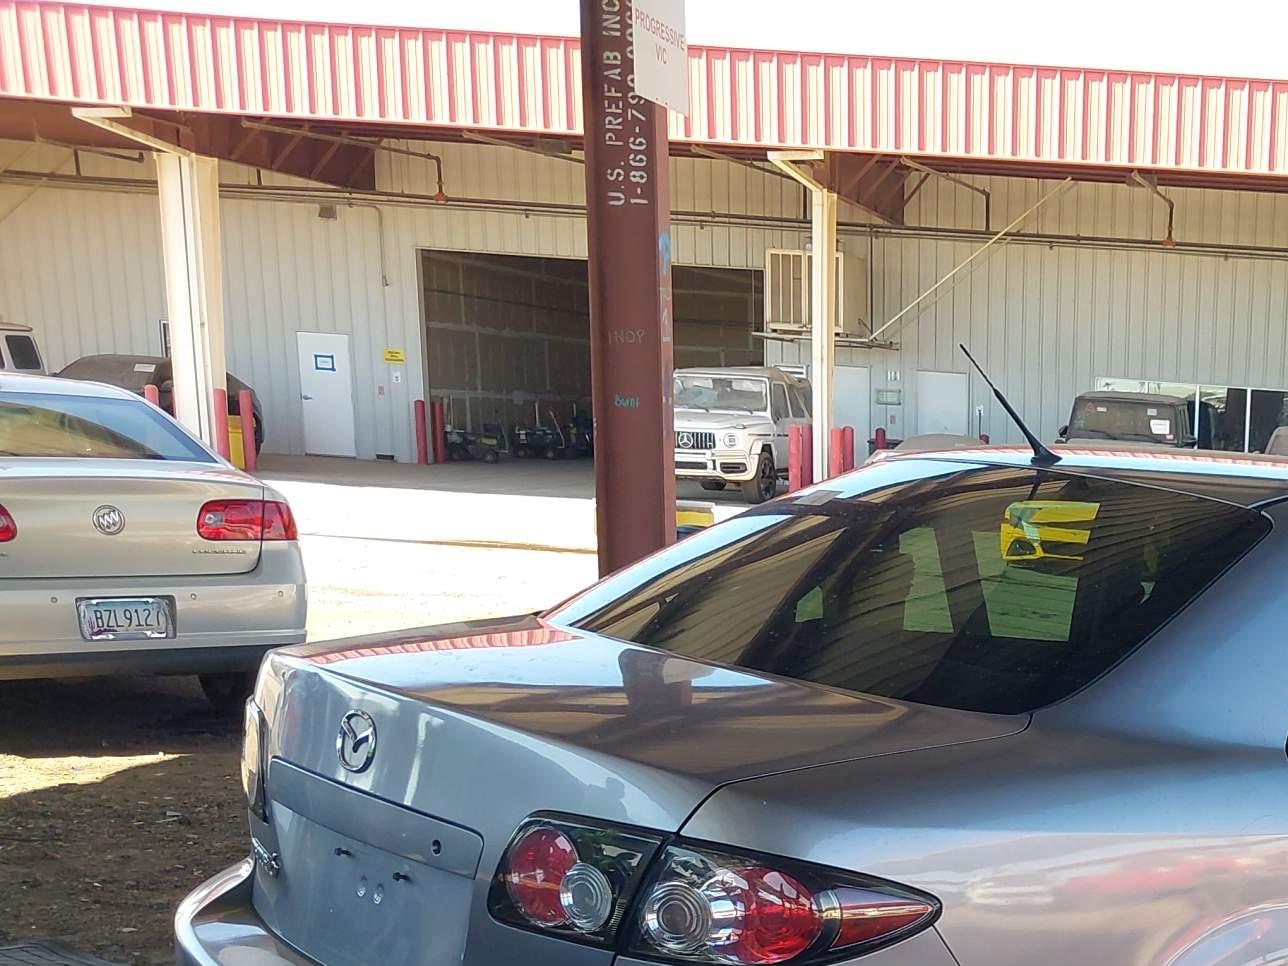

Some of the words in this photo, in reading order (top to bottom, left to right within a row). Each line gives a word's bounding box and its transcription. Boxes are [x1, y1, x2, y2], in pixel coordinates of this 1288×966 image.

[634, 8, 685, 52] PROGRESSIVE
[655, 42, 668, 65] VIC
[602, 49, 625, 146] PREFAB
[607, 160, 626, 206] U.S.
